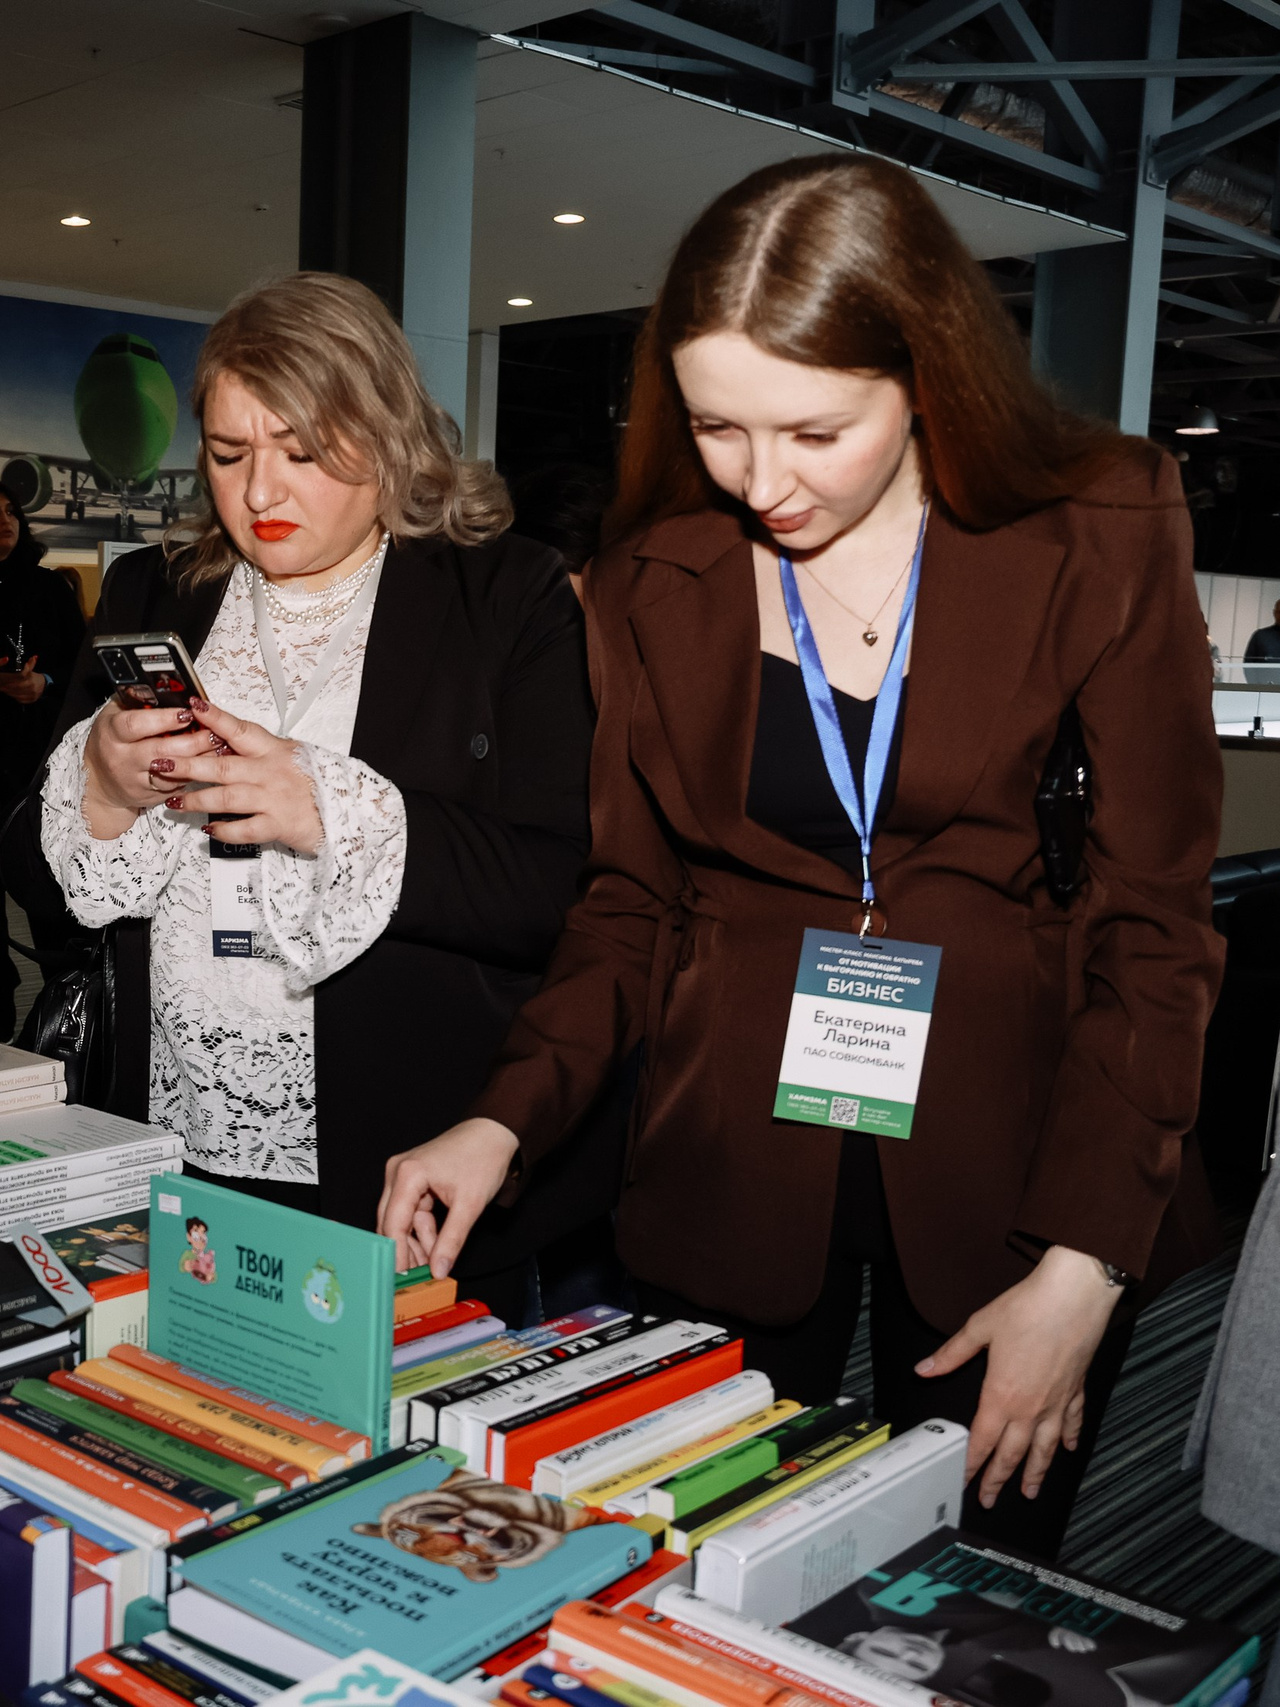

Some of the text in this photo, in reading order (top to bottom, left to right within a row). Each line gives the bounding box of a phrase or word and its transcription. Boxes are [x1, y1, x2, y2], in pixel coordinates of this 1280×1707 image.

[817, 963, 921, 985] К ВЫГОРАНИЮ И ОБРАТНО
[838, 957, 902, 973] ОТ МОТИВАЦИИ
[827, 977, 905, 1003] БИЗНЕС
[814, 1010, 906, 1037] Екатерина
[822, 1028, 890, 1051] Ларина
[803, 1047, 906, 1071] ПАО СОВКОМБАНК
[21, 1234, 73, 1294] 1000
[235, 1244, 284, 1282] ТВОИ
[235, 1275, 284, 1304] ДЕНЬГИ
[310, 1544, 401, 1593] черту
[324, 1535, 460, 1599] вежливо
[277, 1549, 429, 1624] посылать
[295, 1577, 362, 1619] Как
